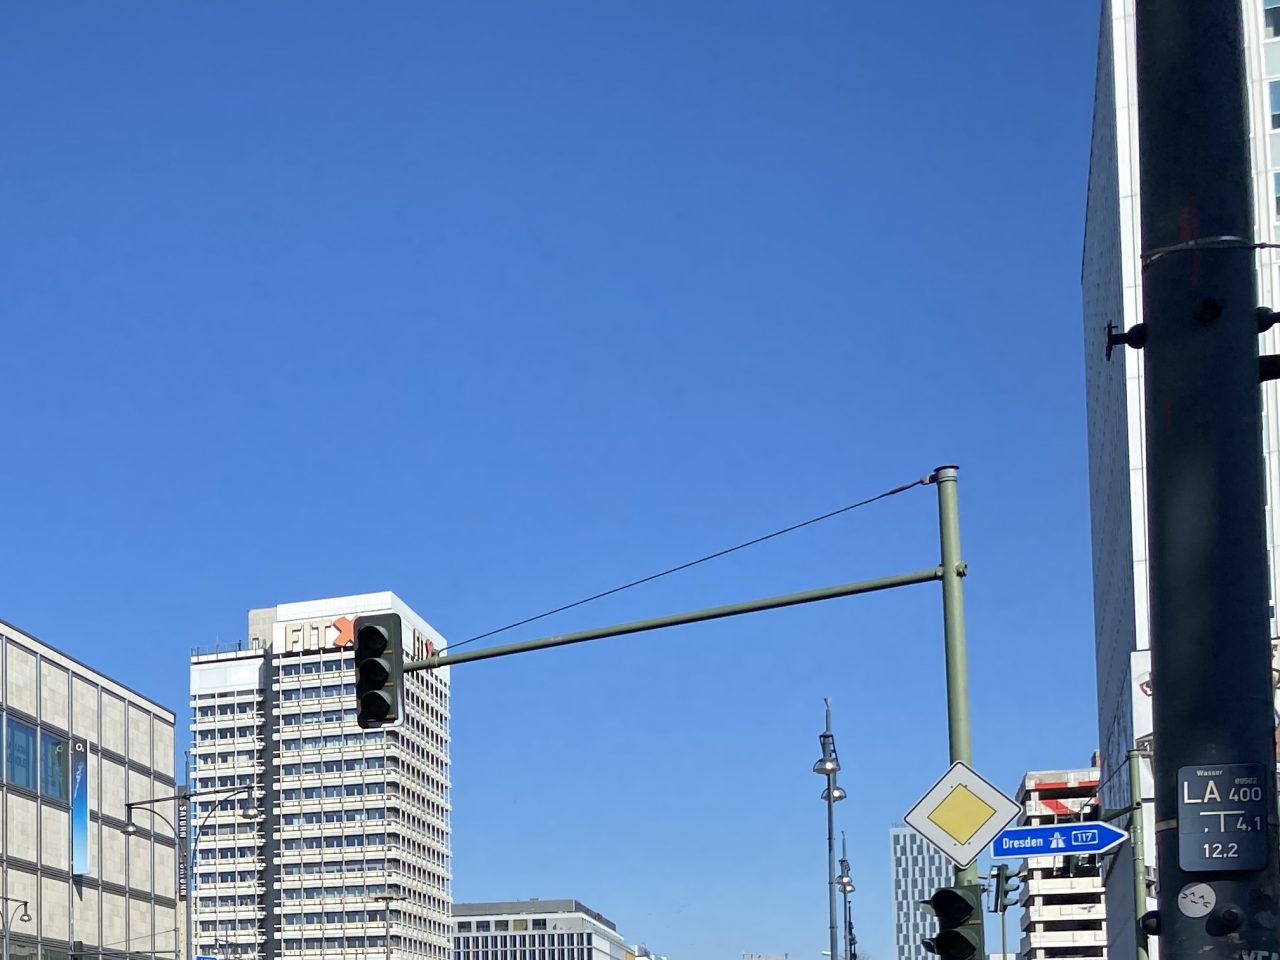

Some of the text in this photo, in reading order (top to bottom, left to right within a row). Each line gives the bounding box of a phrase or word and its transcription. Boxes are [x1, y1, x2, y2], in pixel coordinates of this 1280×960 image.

[1183, 780, 1262, 803] LA 400
[179, 805, 187, 838] SATURN
[1236, 816, 1261, 831] 4,1
[1002, 833, 1093, 849] Dresden 117
[1203, 843, 1239, 858] 12,2
